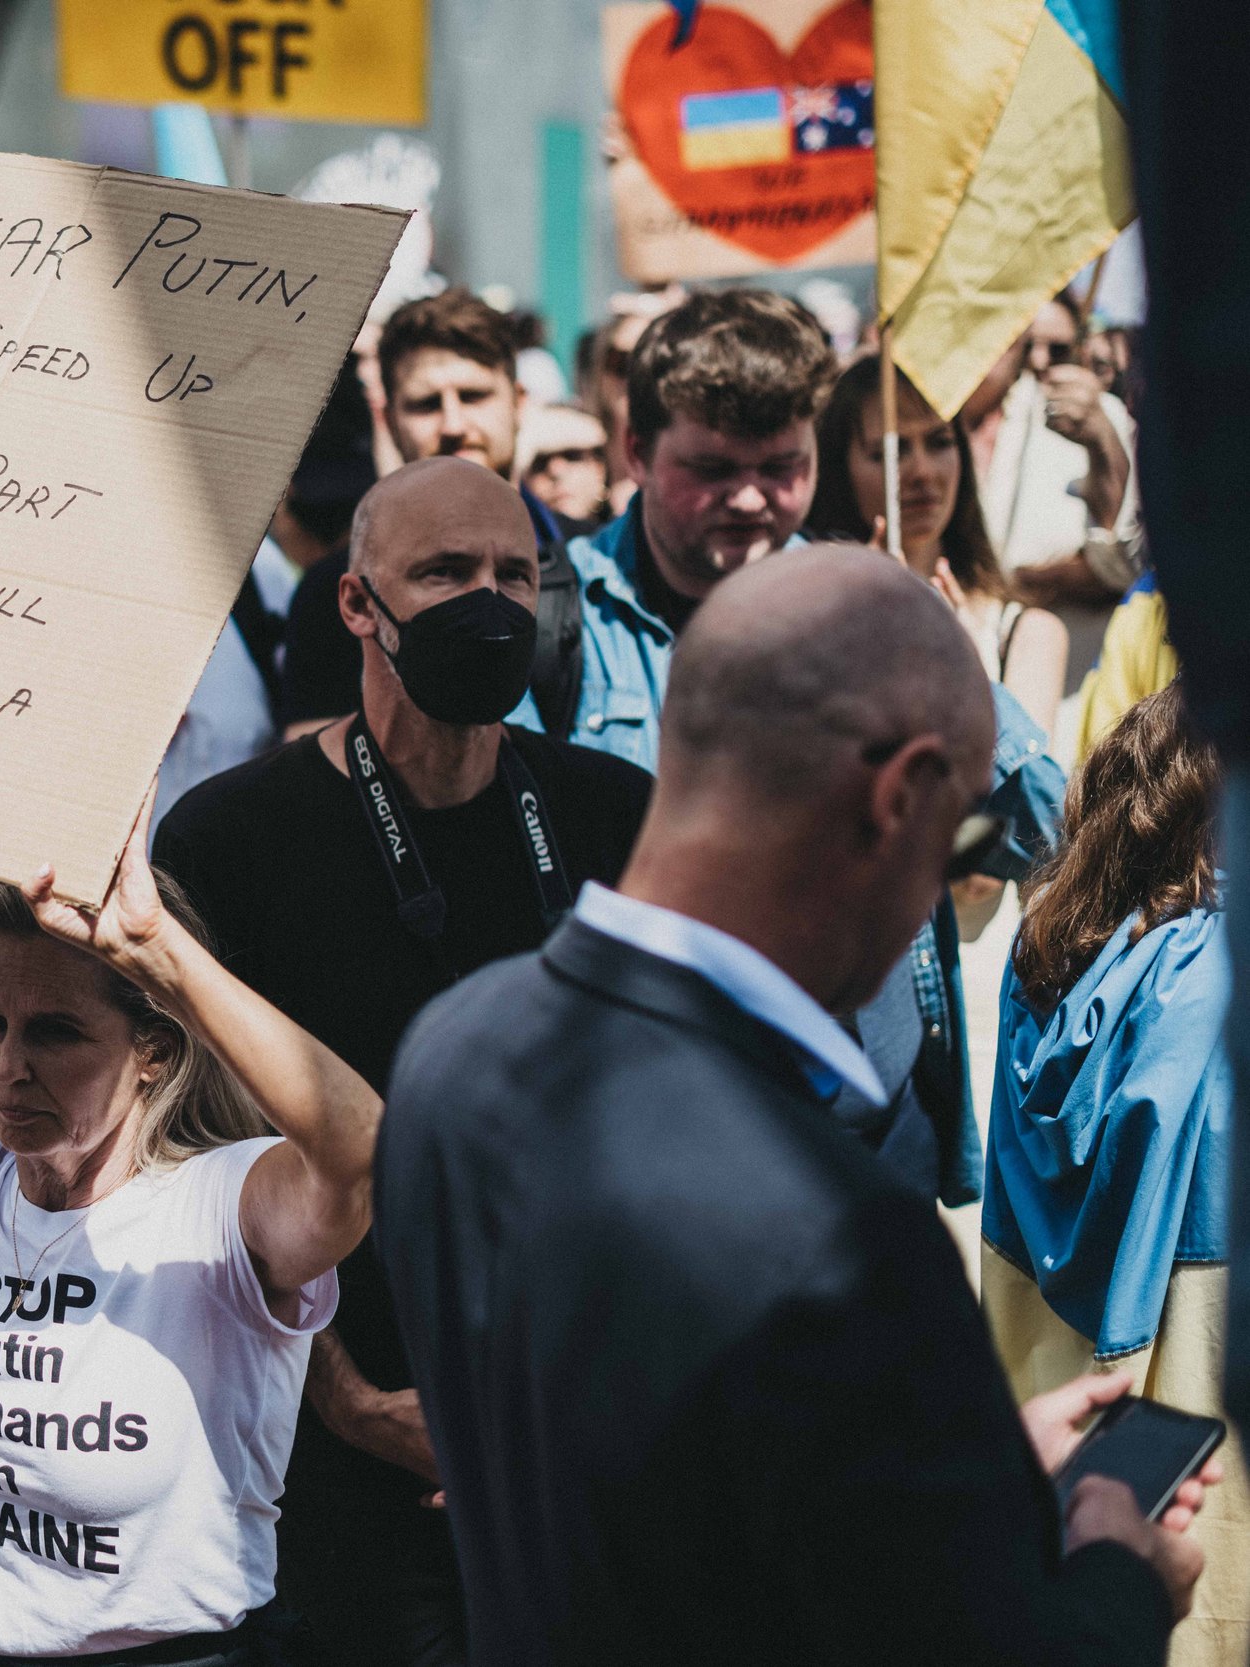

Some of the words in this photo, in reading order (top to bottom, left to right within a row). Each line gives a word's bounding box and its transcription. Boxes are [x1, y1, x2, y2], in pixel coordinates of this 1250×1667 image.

[161, 14, 312, 98] OFF
[112, 212, 318, 323] PUTIN,
[144, 353, 214, 403] UP
[353, 734, 377, 778] EOS
[368, 780, 408, 864] DIGITAL
[520, 790, 555, 873] Canon
